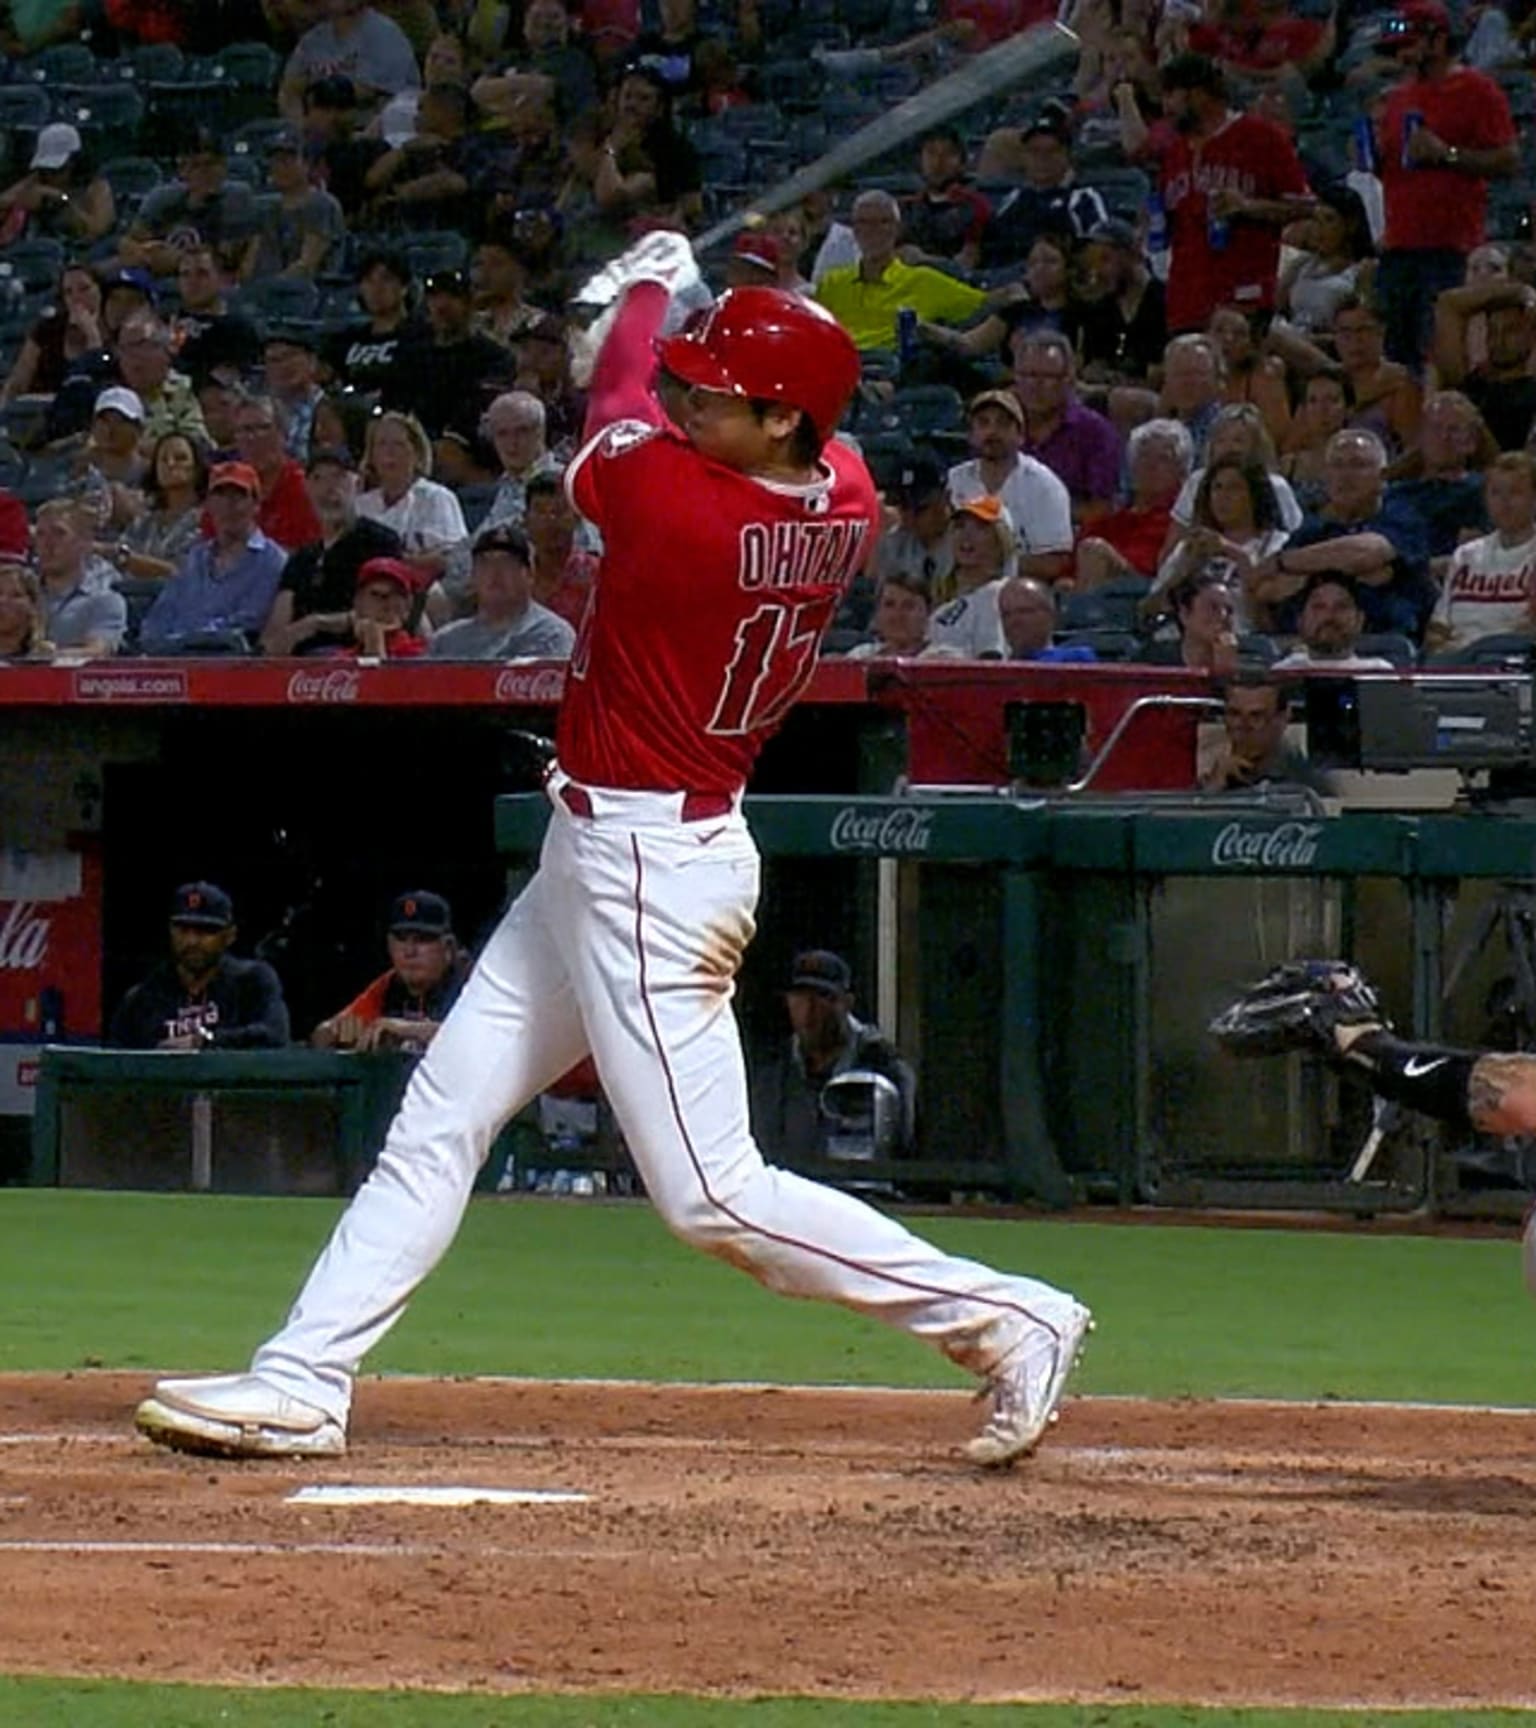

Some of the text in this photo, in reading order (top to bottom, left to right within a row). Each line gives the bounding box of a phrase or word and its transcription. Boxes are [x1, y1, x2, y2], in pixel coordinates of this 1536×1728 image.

[345, 340, 399, 366] UFC
[738, 518, 869, 591] OHTAN
[704, 591, 842, 736] 17
